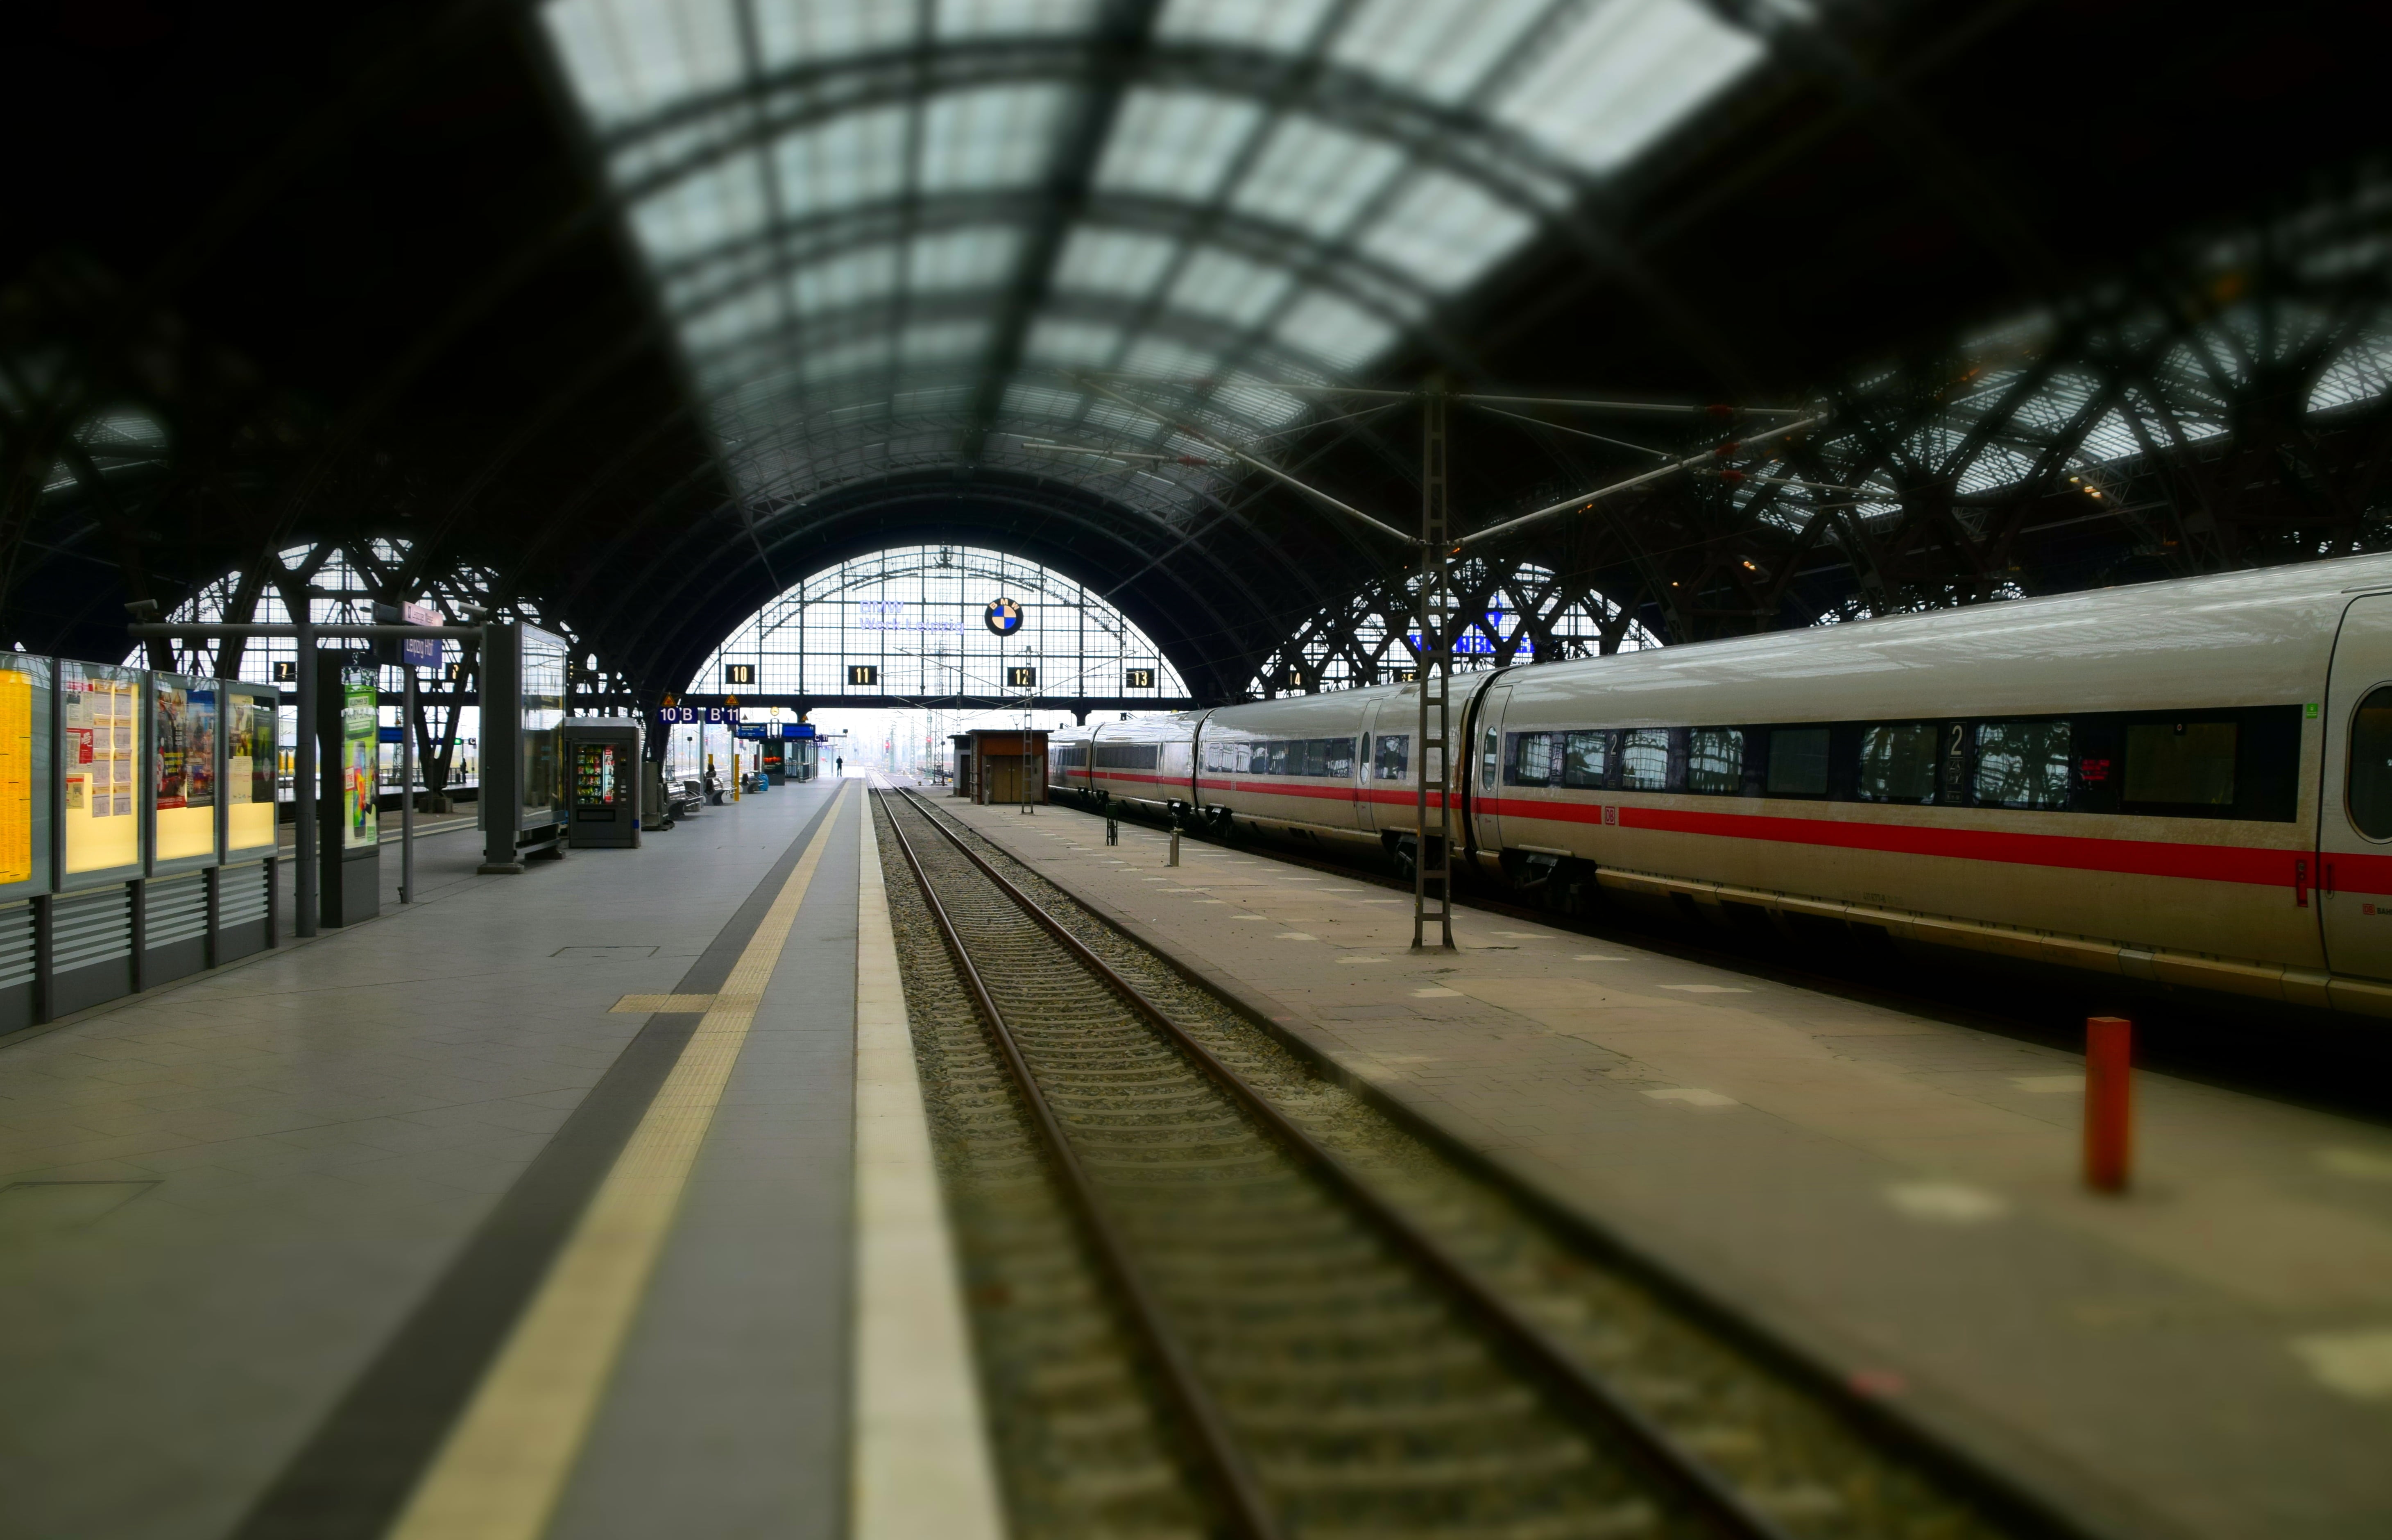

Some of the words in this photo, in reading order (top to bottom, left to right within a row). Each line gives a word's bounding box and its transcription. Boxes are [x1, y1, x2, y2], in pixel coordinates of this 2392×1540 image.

[860, 600, 904, 613] BMW
[989, 598, 1020, 610] BMW
[859, 618, 902, 631] Werk
[905, 618, 964, 635] Leipzig
[406, 639, 424, 659] Leipzig
[425, 639, 434, 656] Hbf
[280, 664, 288, 679] 7
[734, 666, 748, 683] 10
[856, 667, 869, 684] 11
[1015, 669, 1029, 686] 12
[1134, 670, 1148, 687] 13
[660, 708, 676, 721] 10
[683, 708, 693, 721] B
[711, 708, 721, 721] B
[727, 708, 738, 721] 11
[1611, 734, 1617, 755] 2
[1950, 725, 1963, 755] 2
[1606, 808, 1614, 822] DB
[2364, 905, 2373, 914] DB
